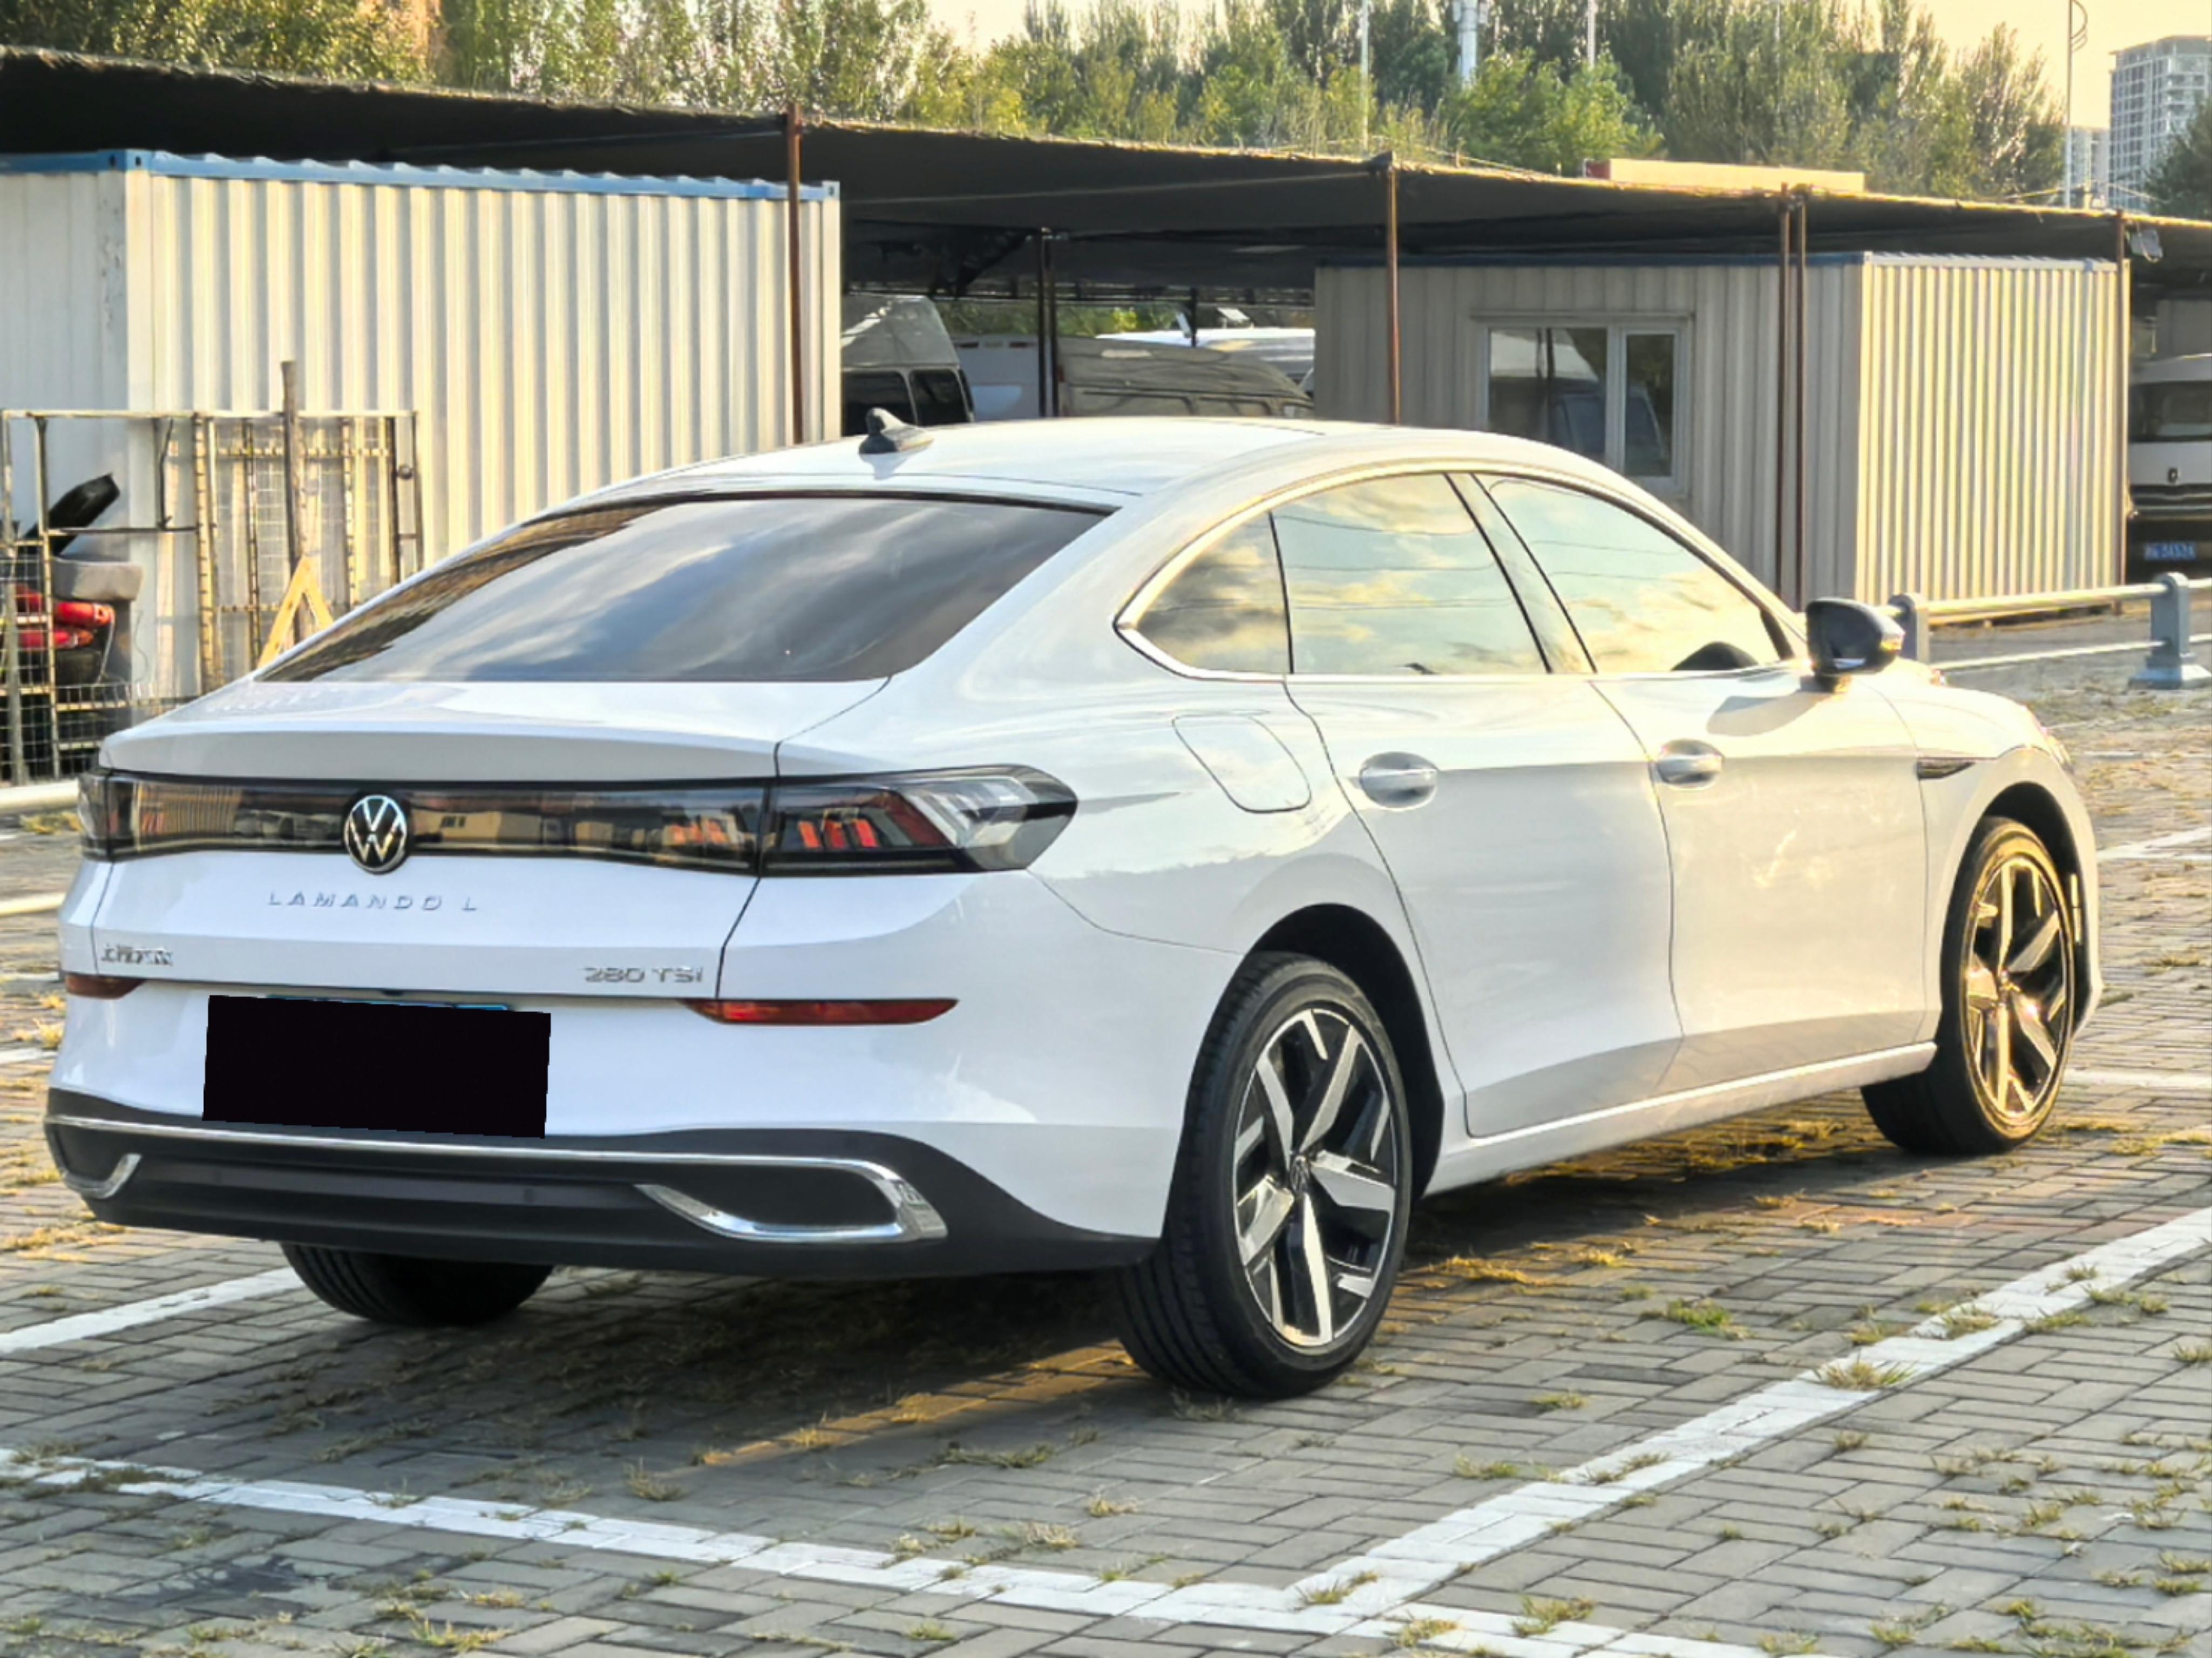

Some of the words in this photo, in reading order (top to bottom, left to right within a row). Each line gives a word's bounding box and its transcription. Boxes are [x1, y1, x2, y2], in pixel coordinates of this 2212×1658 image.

[268, 891, 442, 911] LAMANDO
[462, 896, 478, 911] L
[584, 967, 646, 983] 280
[652, 966, 703, 983] TSI
